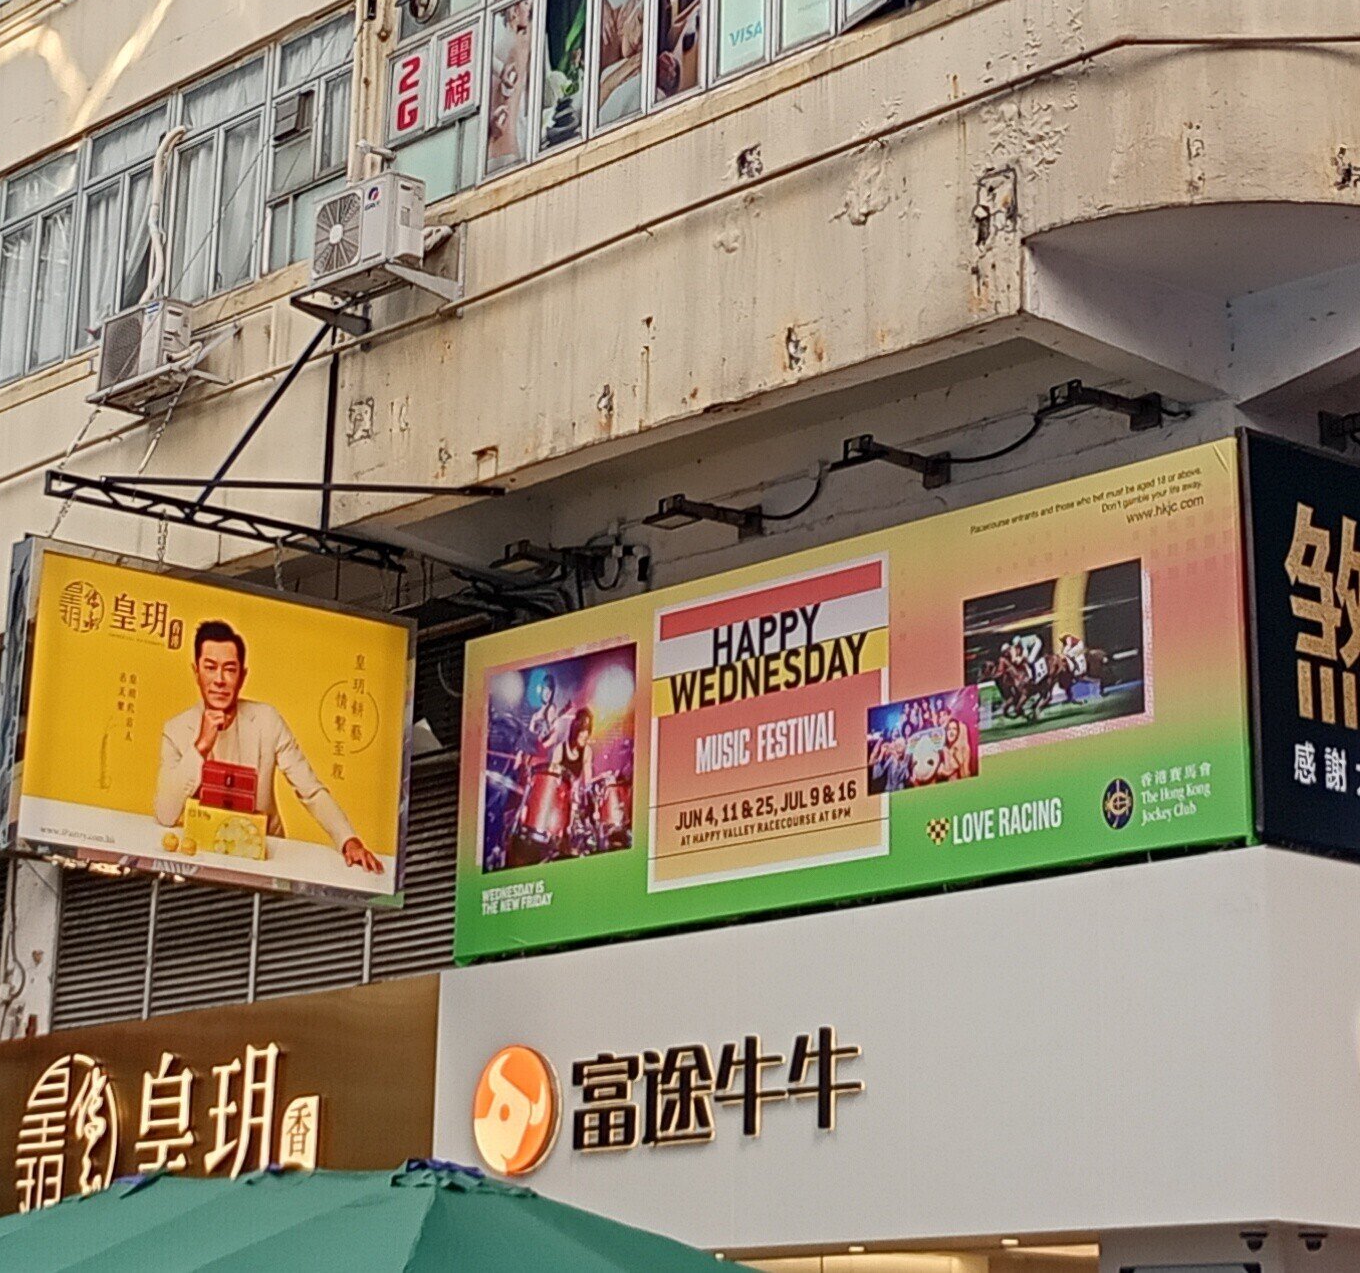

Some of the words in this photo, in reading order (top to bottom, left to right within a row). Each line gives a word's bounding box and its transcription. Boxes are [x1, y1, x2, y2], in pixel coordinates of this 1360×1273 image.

[728, 21, 764, 48] VISA
[444, 32, 473, 112] 電梯
[1041, 505, 1054, 516] and
[1055, 500, 1076, 514] those
[1076, 495, 1091, 508] who
[1126, 483, 1136, 494] be
[1137, 478, 1156, 493] aged
[1157, 474, 1167, 485] 18
[1168, 473, 1176, 482] or
[1123, 493, 1150, 510] gamble
[1151, 487, 1168, 502] your
[1126, 494, 1204, 524] www.hkjc.com
[109, 593, 168, 638] 皇玥
[712, 603, 821, 667] HAPPY
[669, 631, 869, 714] WEDNESDAY
[695, 727, 750, 774] MUSIC
[757, 710, 837, 763] FESTIVAL
[675, 807, 703, 831] JUN
[705, 805, 718, 827] 4,
[722, 803, 738, 824] 11
[742, 800, 753, 818] &
[756, 795, 777, 817] 25,
[780, 790, 808, 812] JUL
[810, 787, 820, 805] 9
[822, 784, 835, 804] &
[838, 780, 857, 801] 16
[1140, 789, 1159, 805] The
[1160, 784, 1185, 802] Hong
[1185, 781, 1212, 798] Kong
[1140, 807, 1173, 827] Jockey
[1174, 801, 1197, 819] Club
[680, 834, 691, 846] AT
[692, 829, 722, 845] HAPPY
[723, 823, 756, 840] VALLEY
[757, 813, 817, 834] RACECOURSE
[818, 810, 831, 822] AT
[952, 808, 995, 845] LOVE
[998, 797, 1062, 836] RACING
[134, 1042, 280, 1180] 皇玥
[571, 1026, 864, 1154] 富途牛牛
